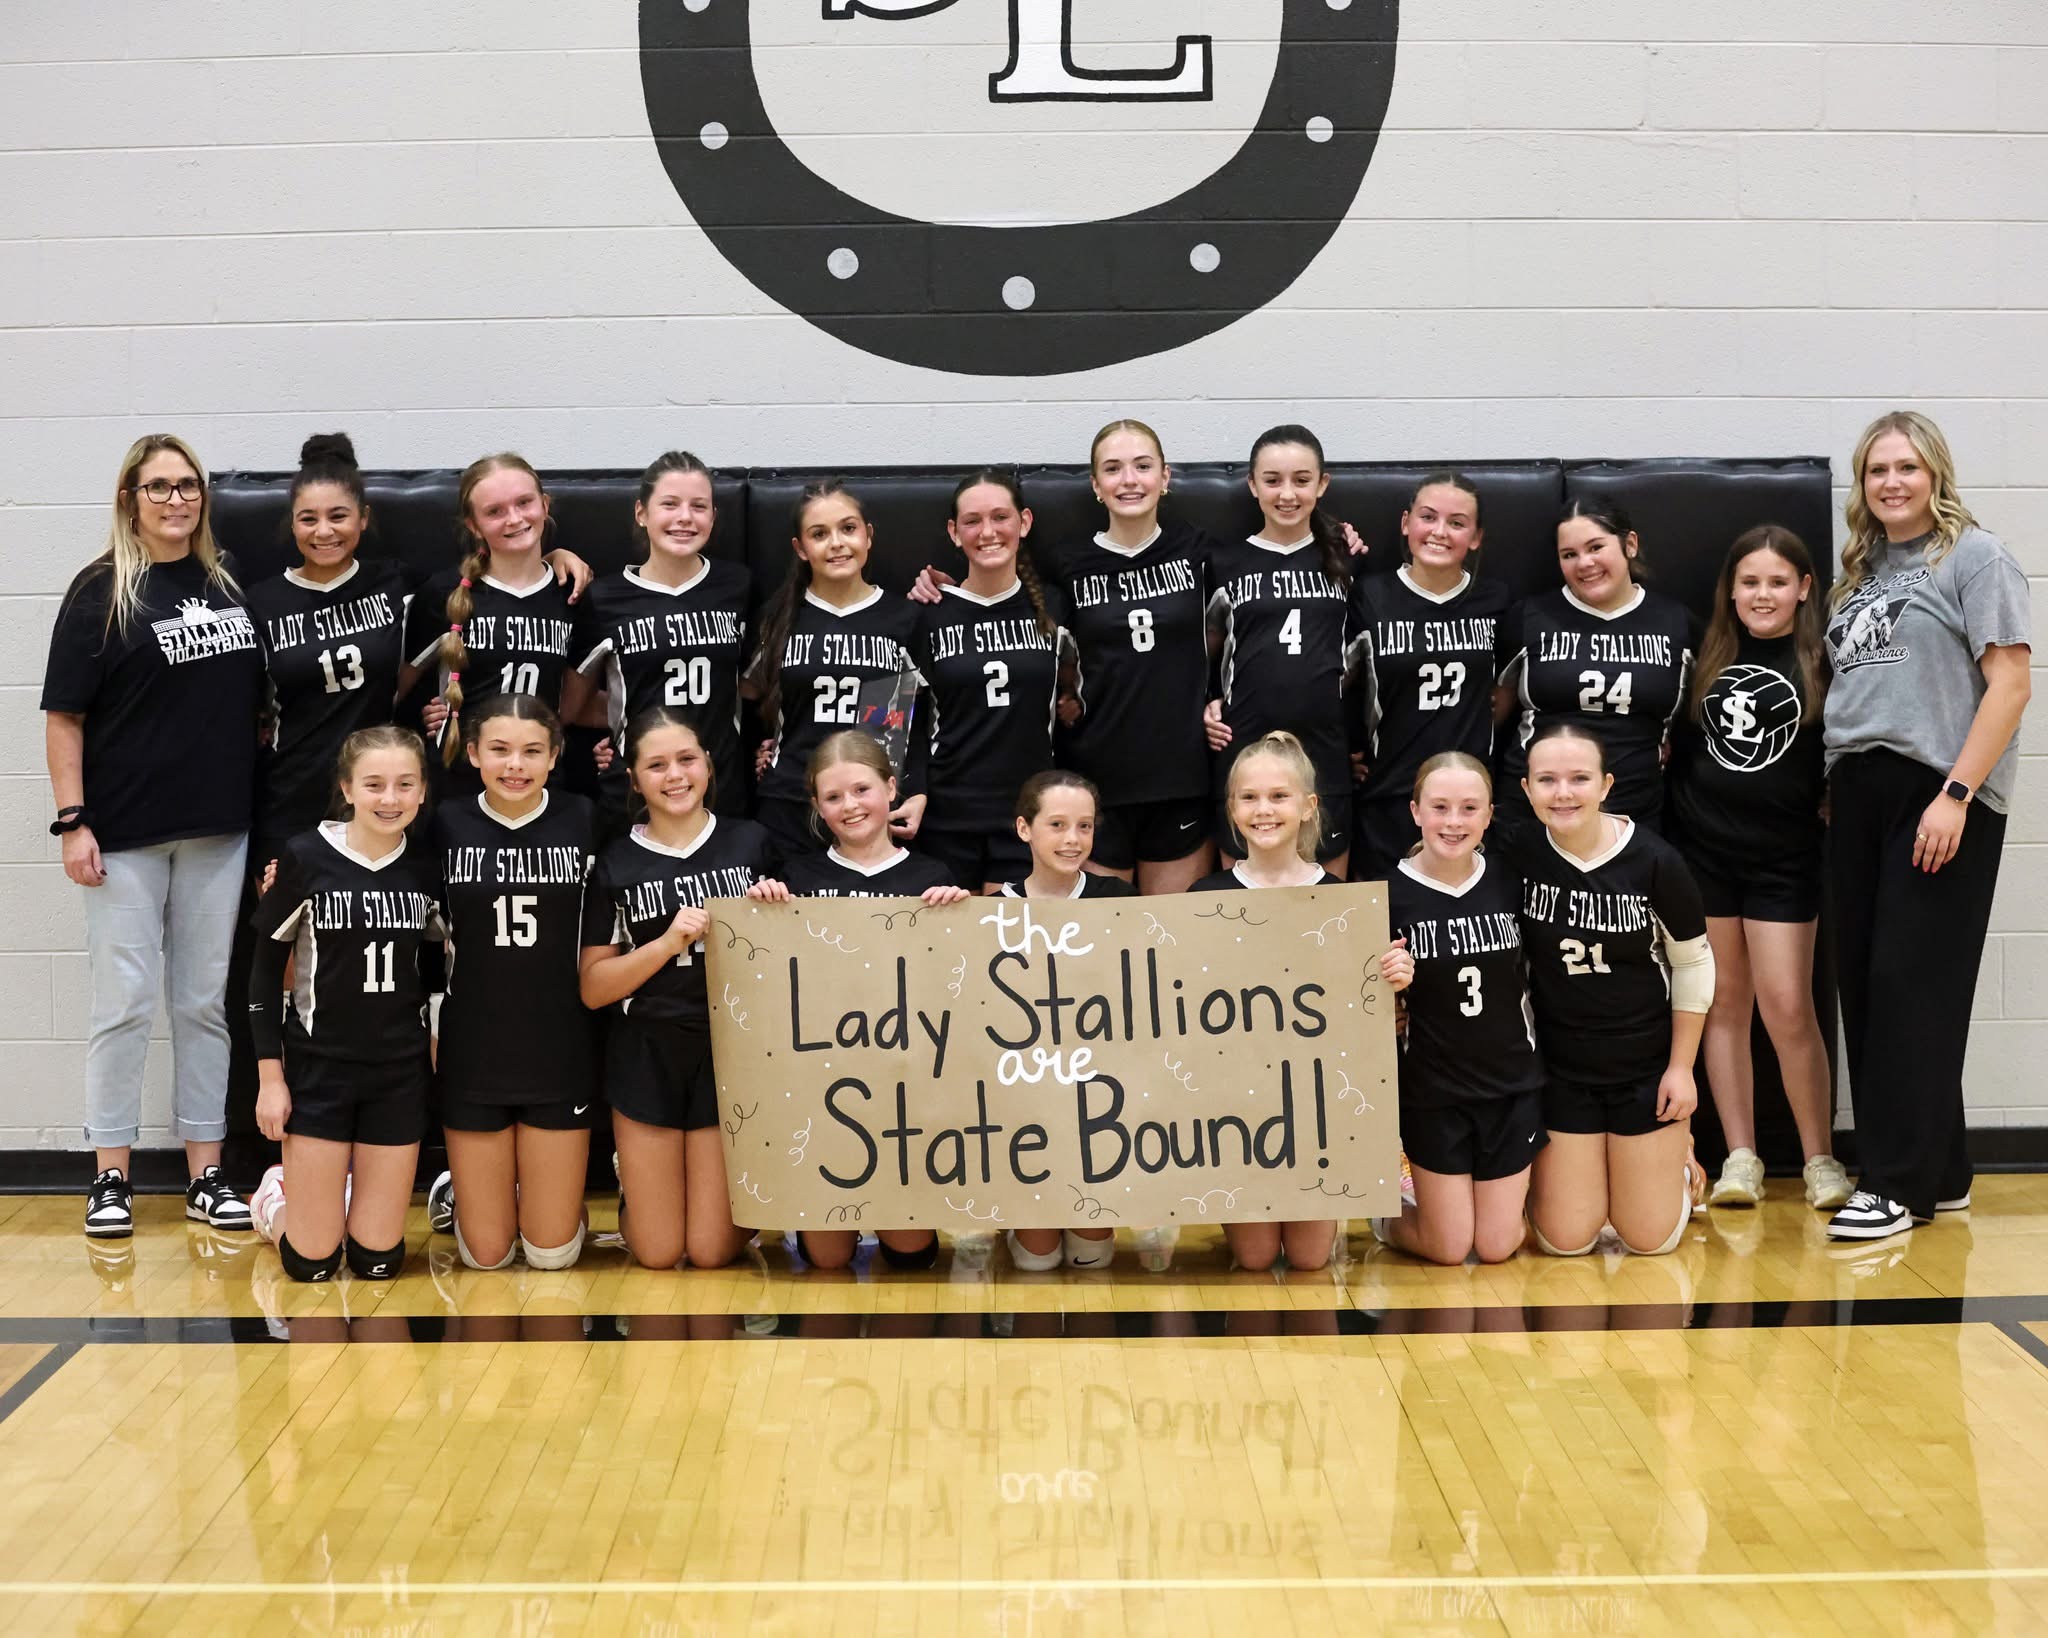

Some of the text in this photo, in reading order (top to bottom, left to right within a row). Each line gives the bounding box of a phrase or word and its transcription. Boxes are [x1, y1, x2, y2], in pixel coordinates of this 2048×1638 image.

[175, 597, 209, 612] LADY
[1073, 558, 1195, 609] LADY STALLIONS
[156, 617, 255, 651] STALLIONS
[268, 592, 395, 652] LADY STALLIONS
[463, 616, 496, 650] ADY
[618, 616, 657, 655] LADY
[930, 624, 964, 662] LADY
[1127, 608, 1155, 653] 8
[1278, 608, 1302, 655] 4
[1377, 621, 1415, 656] LADY
[165, 633, 257, 666] VOLLEYBALL
[318, 644, 365, 694] 13
[781, 633, 898, 672] ADY STALLIONS
[1540, 631, 1672, 667] LADY STALLIONS
[1855, 647, 1908, 663] Lawrence
[663, 656, 712, 706] 20
[813, 675, 862, 724] 22
[983, 660, 1010, 708] 2
[1418, 661, 1466, 711] 23
[1578, 669, 1632, 715] 24
[448, 846, 581, 884] LADY STALLIONS
[315, 891, 352, 929] LADY
[493, 895, 538, 947] 15
[624, 880, 667, 923] LADY
[1523, 877, 1648, 933] LADY STALLIONS
[979, 902, 1094, 956] the
[1397, 920, 1437, 959] ADY
[363, 941, 396, 993] 11
[1559, 938, 1613, 975] 21
[789, 947, 1328, 1078] Lady Stallions
[1457, 965, 1484, 1017] 3
[996, 1047, 1098, 1086] are
[819, 1058, 1329, 1189] State Bound!
